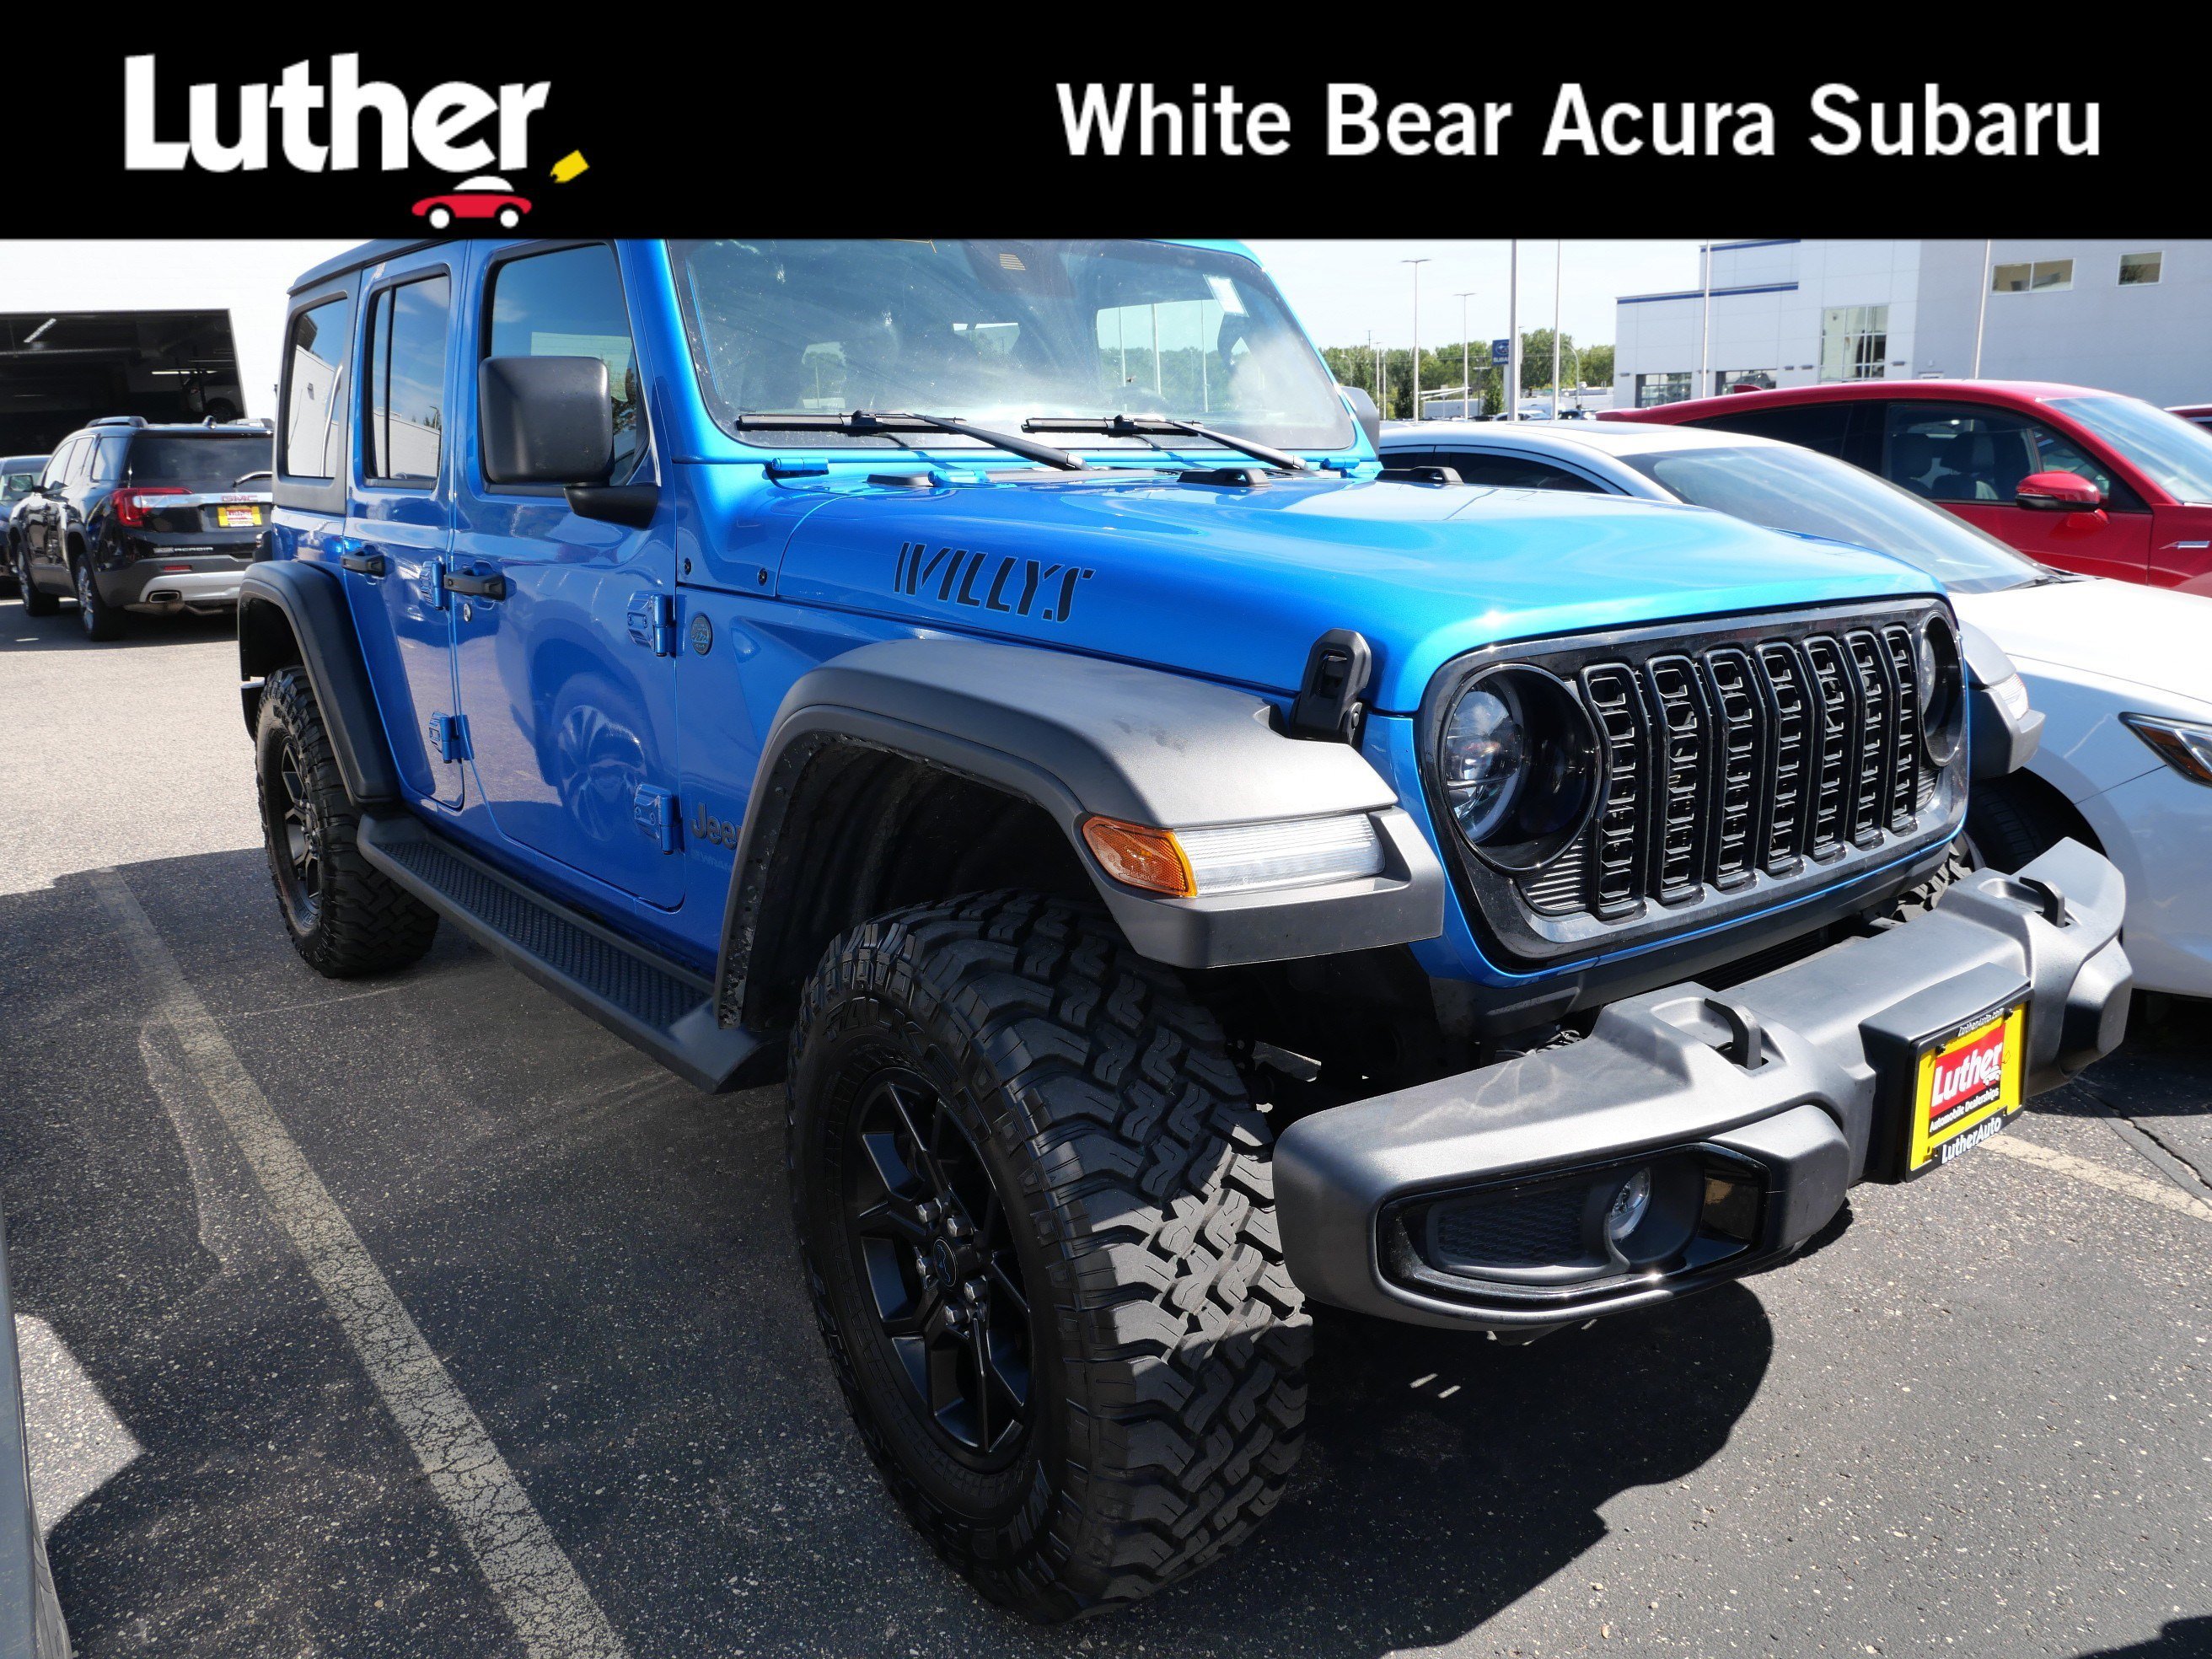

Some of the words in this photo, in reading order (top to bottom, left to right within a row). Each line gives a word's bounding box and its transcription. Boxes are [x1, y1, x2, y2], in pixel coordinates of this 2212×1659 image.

[221, 494, 258, 502] GMC
[894, 541, 1096, 624] WILLYS
[690, 802, 743, 851] Jee
[1931, 1043, 2003, 1107] Luther
[1929, 1105, 1965, 1132] Automobile
[1964, 1087, 2000, 1113] Dealerships
[1941, 1117, 2002, 1164] LutherAuto
